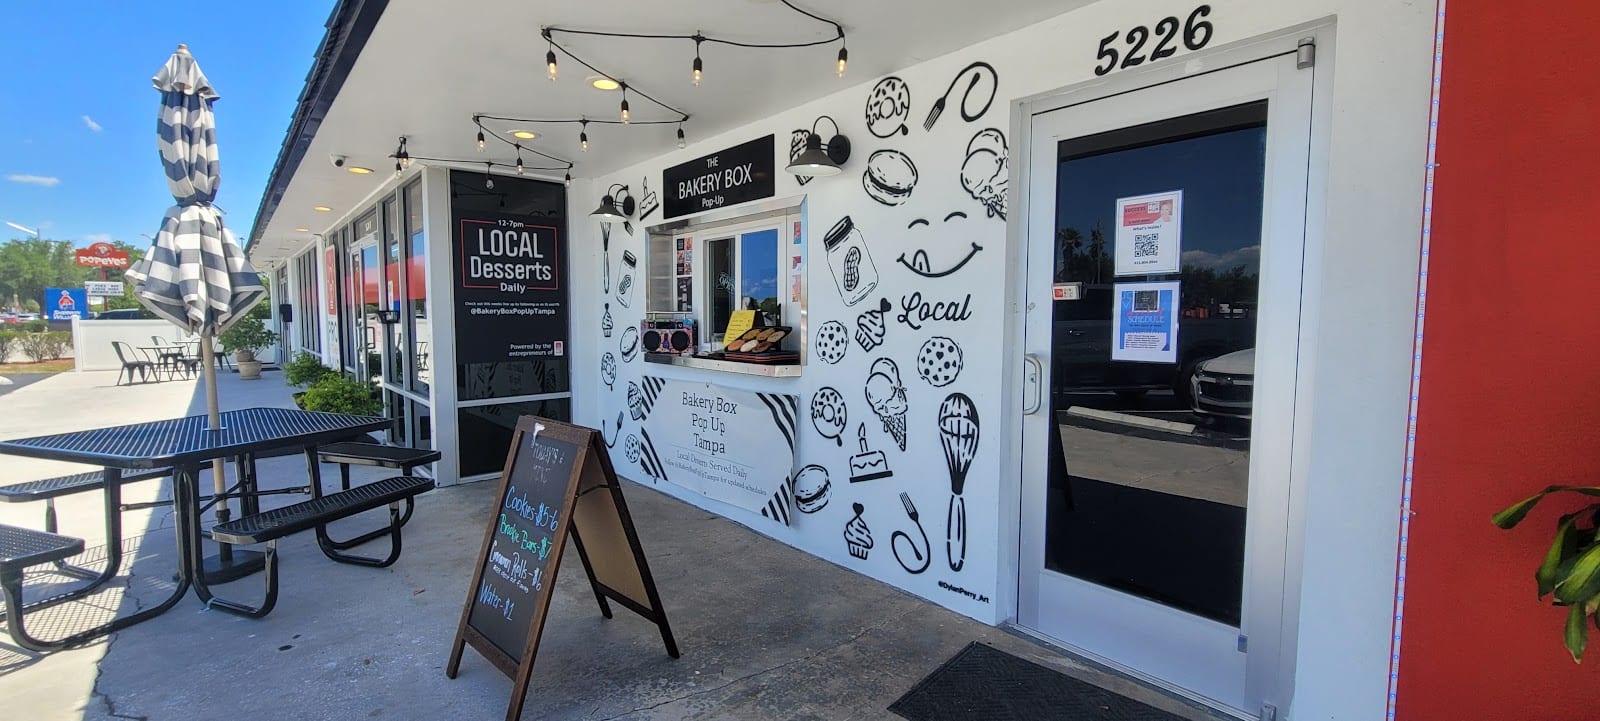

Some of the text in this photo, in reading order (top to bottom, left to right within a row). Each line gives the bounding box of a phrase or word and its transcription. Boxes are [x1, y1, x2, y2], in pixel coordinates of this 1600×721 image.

[1094, 4, 1214, 76] 5226
[706, 156, 719, 168] THE
[678, 163, 752, 199] BAKERY BOX
[702, 195, 724, 208] Pop-Up
[498, 220, 524, 228] 12-7pm
[479, 228, 544, 258] LOCAL
[470, 256, 552, 280] Desserts
[500, 282, 526, 294] Daily
[470, 308, 555, 316] @BakeryBoxPopUpTampa
[897, 291, 972, 330] Local
[682, 392, 738, 414] Bakery Box
[692, 413, 725, 436] Pop Up
[694, 432, 725, 455] Tampa
[709, 460, 732, 474] Served
